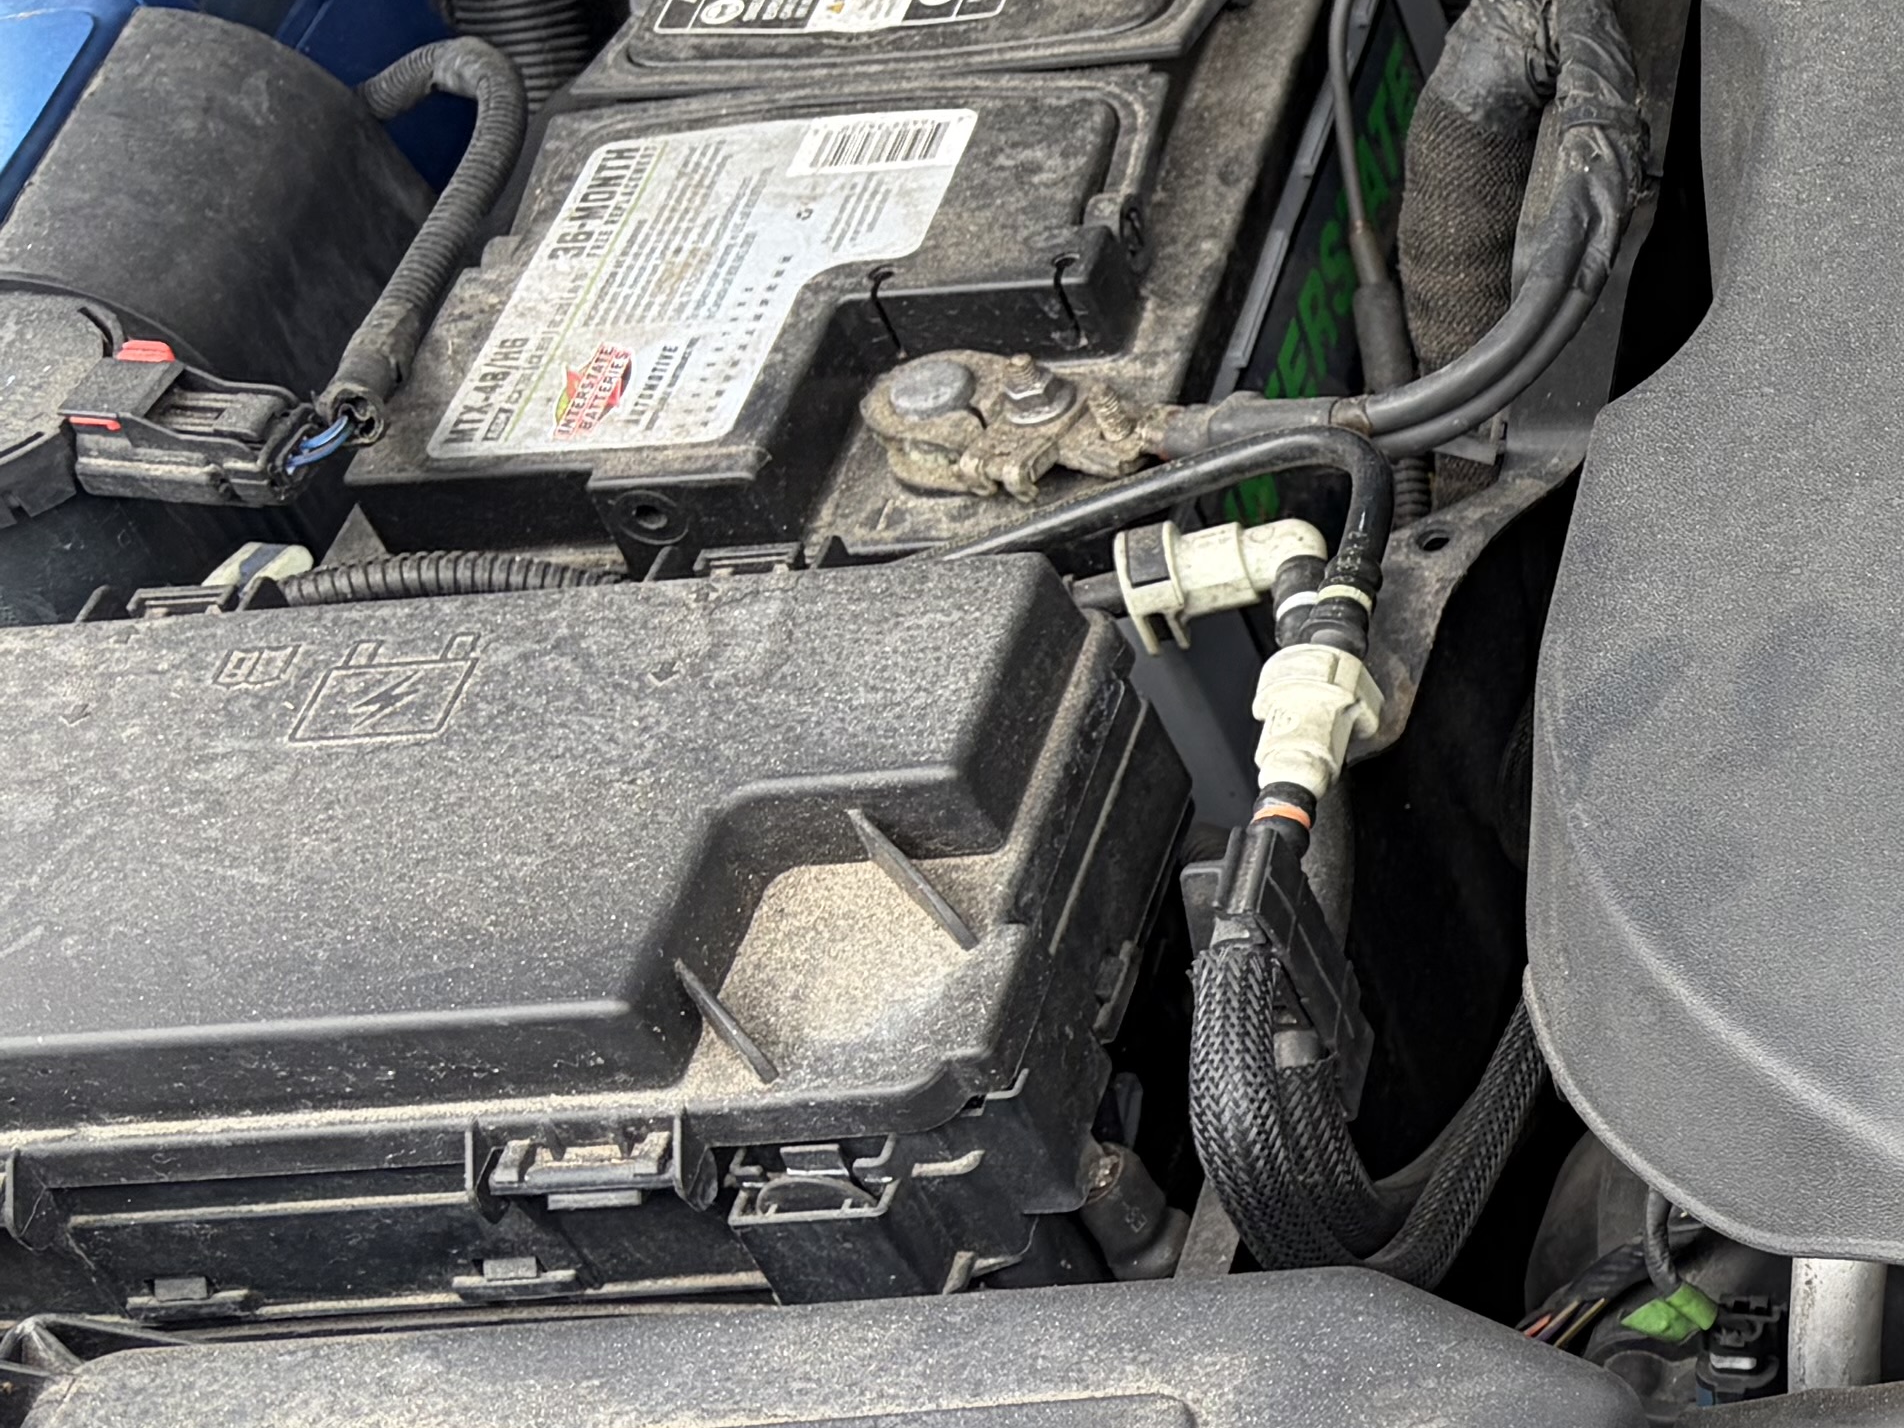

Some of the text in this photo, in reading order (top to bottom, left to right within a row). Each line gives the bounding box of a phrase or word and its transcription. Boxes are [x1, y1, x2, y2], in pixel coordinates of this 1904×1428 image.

[544, 145, 642, 261] 36-MONTH
[554, 345, 617, 435] INTERSTATE
[575, 350, 632, 430] BATTERIES
[622, 343, 680, 426] AUTOMOTIVE
